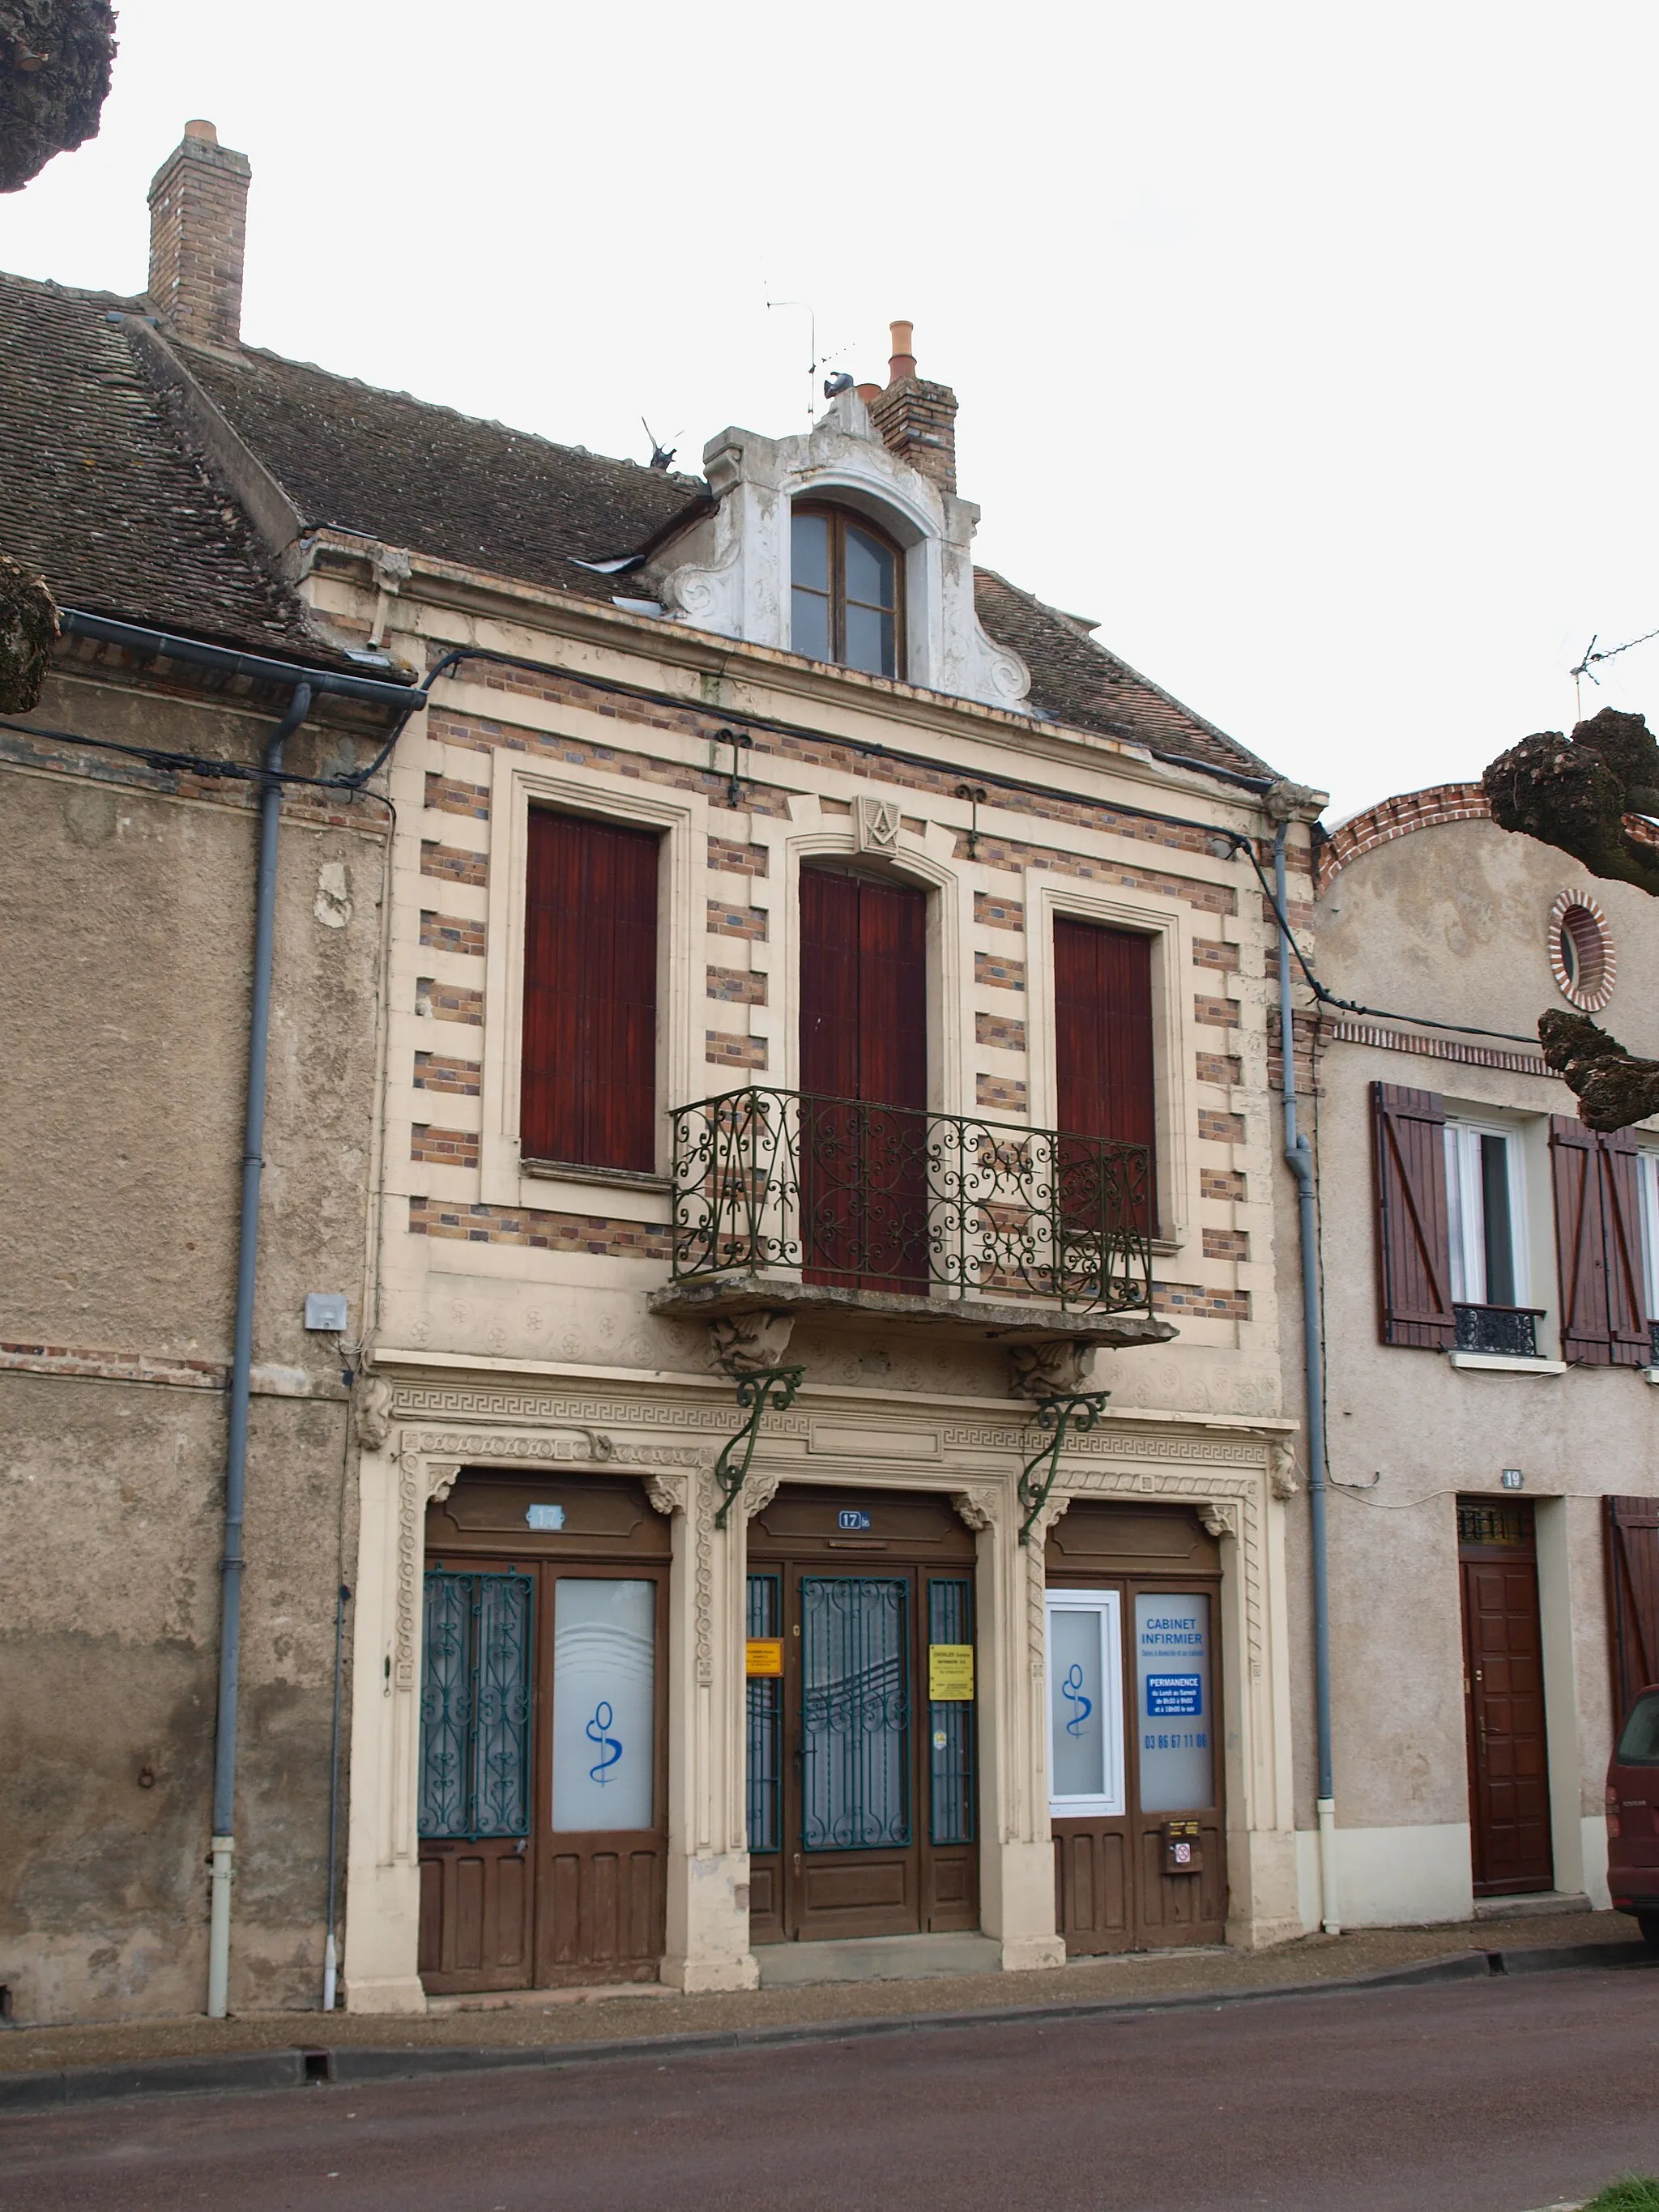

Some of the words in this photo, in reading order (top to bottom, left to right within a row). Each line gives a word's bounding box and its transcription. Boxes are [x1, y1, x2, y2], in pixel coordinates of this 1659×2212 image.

[1507, 1471, 1520, 1486] 19
[537, 1509, 555, 1528] 17
[843, 1514, 857, 1527] 17
[1146, 1618, 1196, 1630] CABINET
[1141, 1634, 1202, 1644] INFIRMIER
[1150, 1678, 1199, 1687] PERMANENCE
[1145, 1735, 1155, 1749] 03
[1158, 1735, 1168, 1749] 86
[1171, 1734, 1180, 1748] 67
[1183, 1734, 1192, 1747] 11
